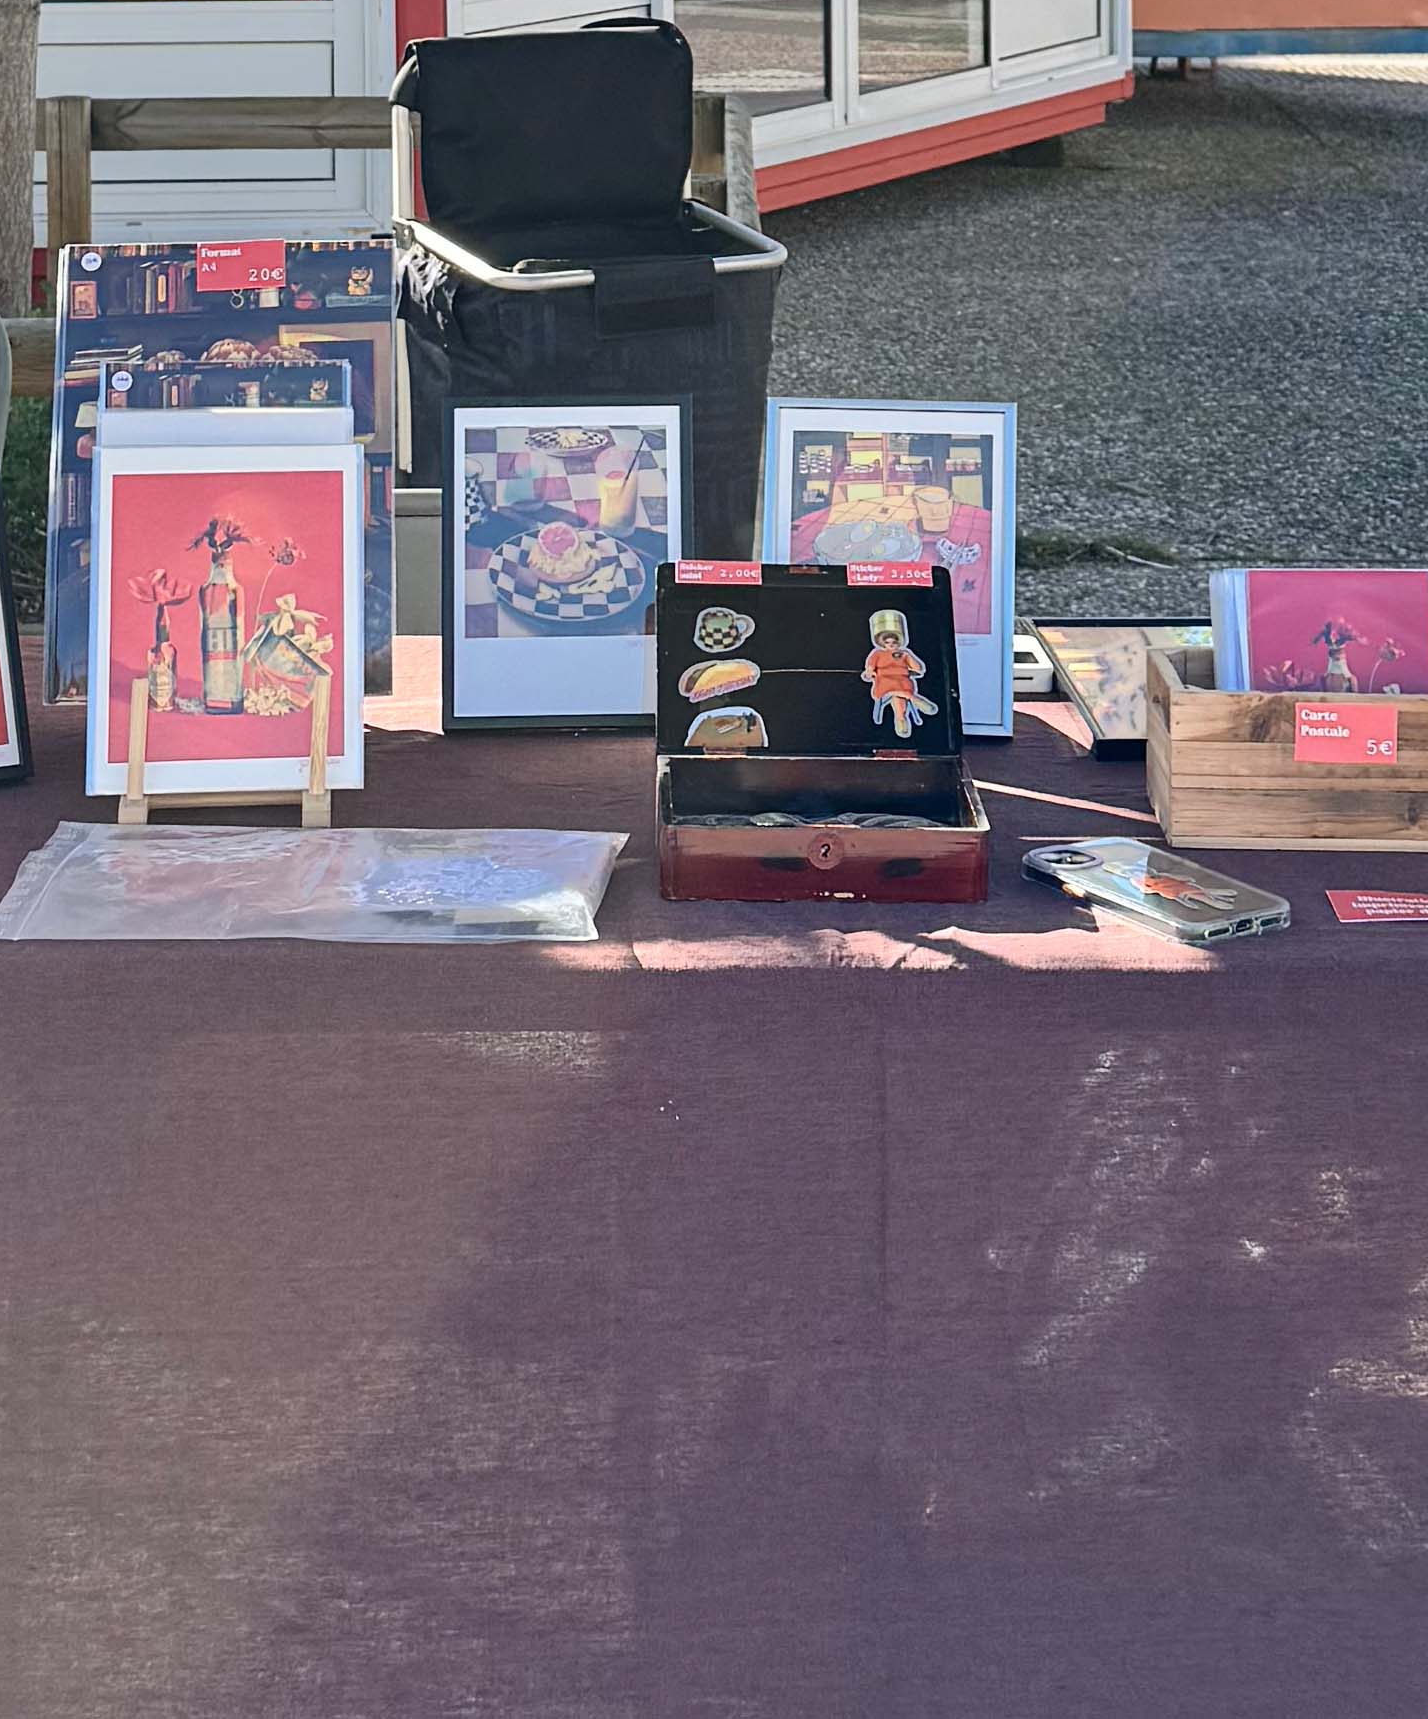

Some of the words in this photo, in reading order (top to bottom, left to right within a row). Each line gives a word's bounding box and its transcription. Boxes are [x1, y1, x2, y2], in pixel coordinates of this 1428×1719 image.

[201, 247, 242, 258] Format
[201, 262, 217, 272] A4
[248, 267, 284, 282] 20€
[719, 568, 759, 578] 2.00€
[1300, 708, 1338, 721] Carte
[1300, 724, 1350, 738] Postale
[1366, 739, 1393, 755] 5€
